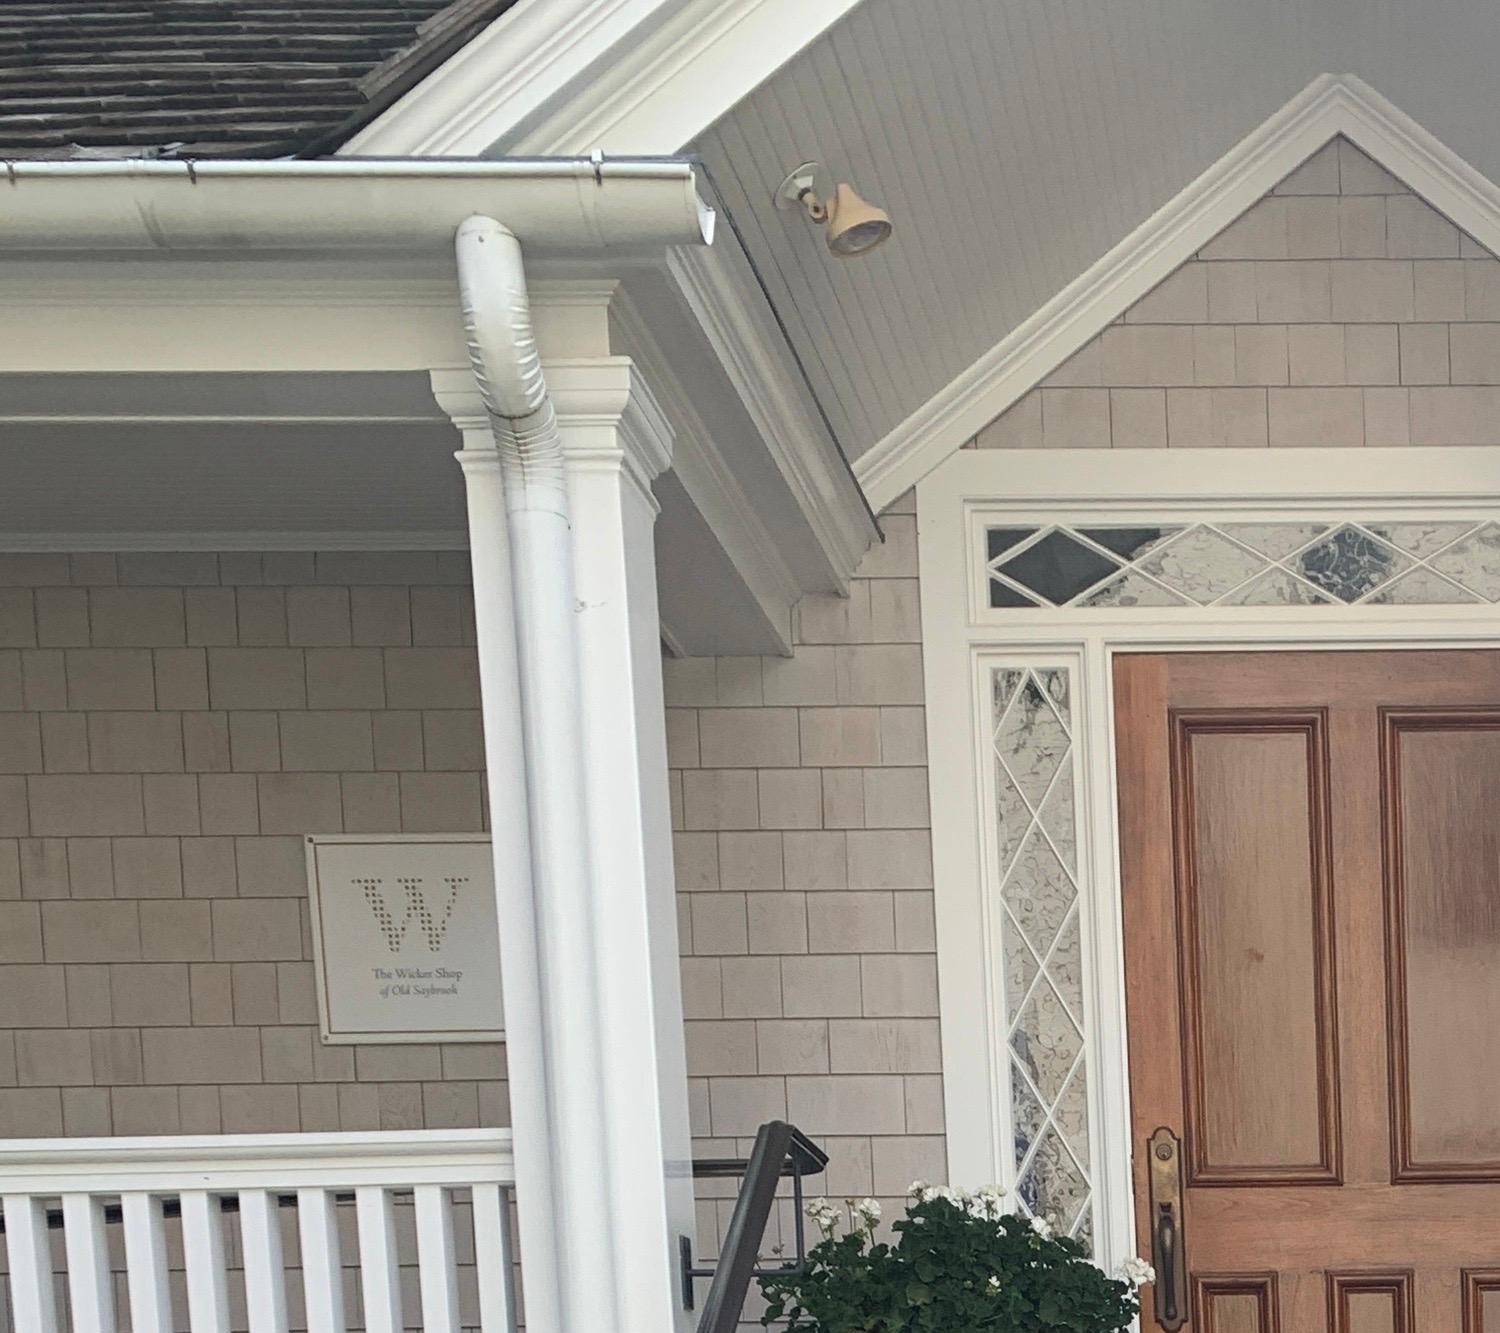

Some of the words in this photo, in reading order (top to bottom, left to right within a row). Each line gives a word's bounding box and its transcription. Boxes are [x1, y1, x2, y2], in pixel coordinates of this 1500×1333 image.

[372, 968, 392, 979] The
[395, 967, 432, 979] Wicker
[435, 967, 463, 982] Shop
[379, 985, 389, 999] of
[392, 984, 410, 996] Old
[413, 984, 458, 998] Saybrook
